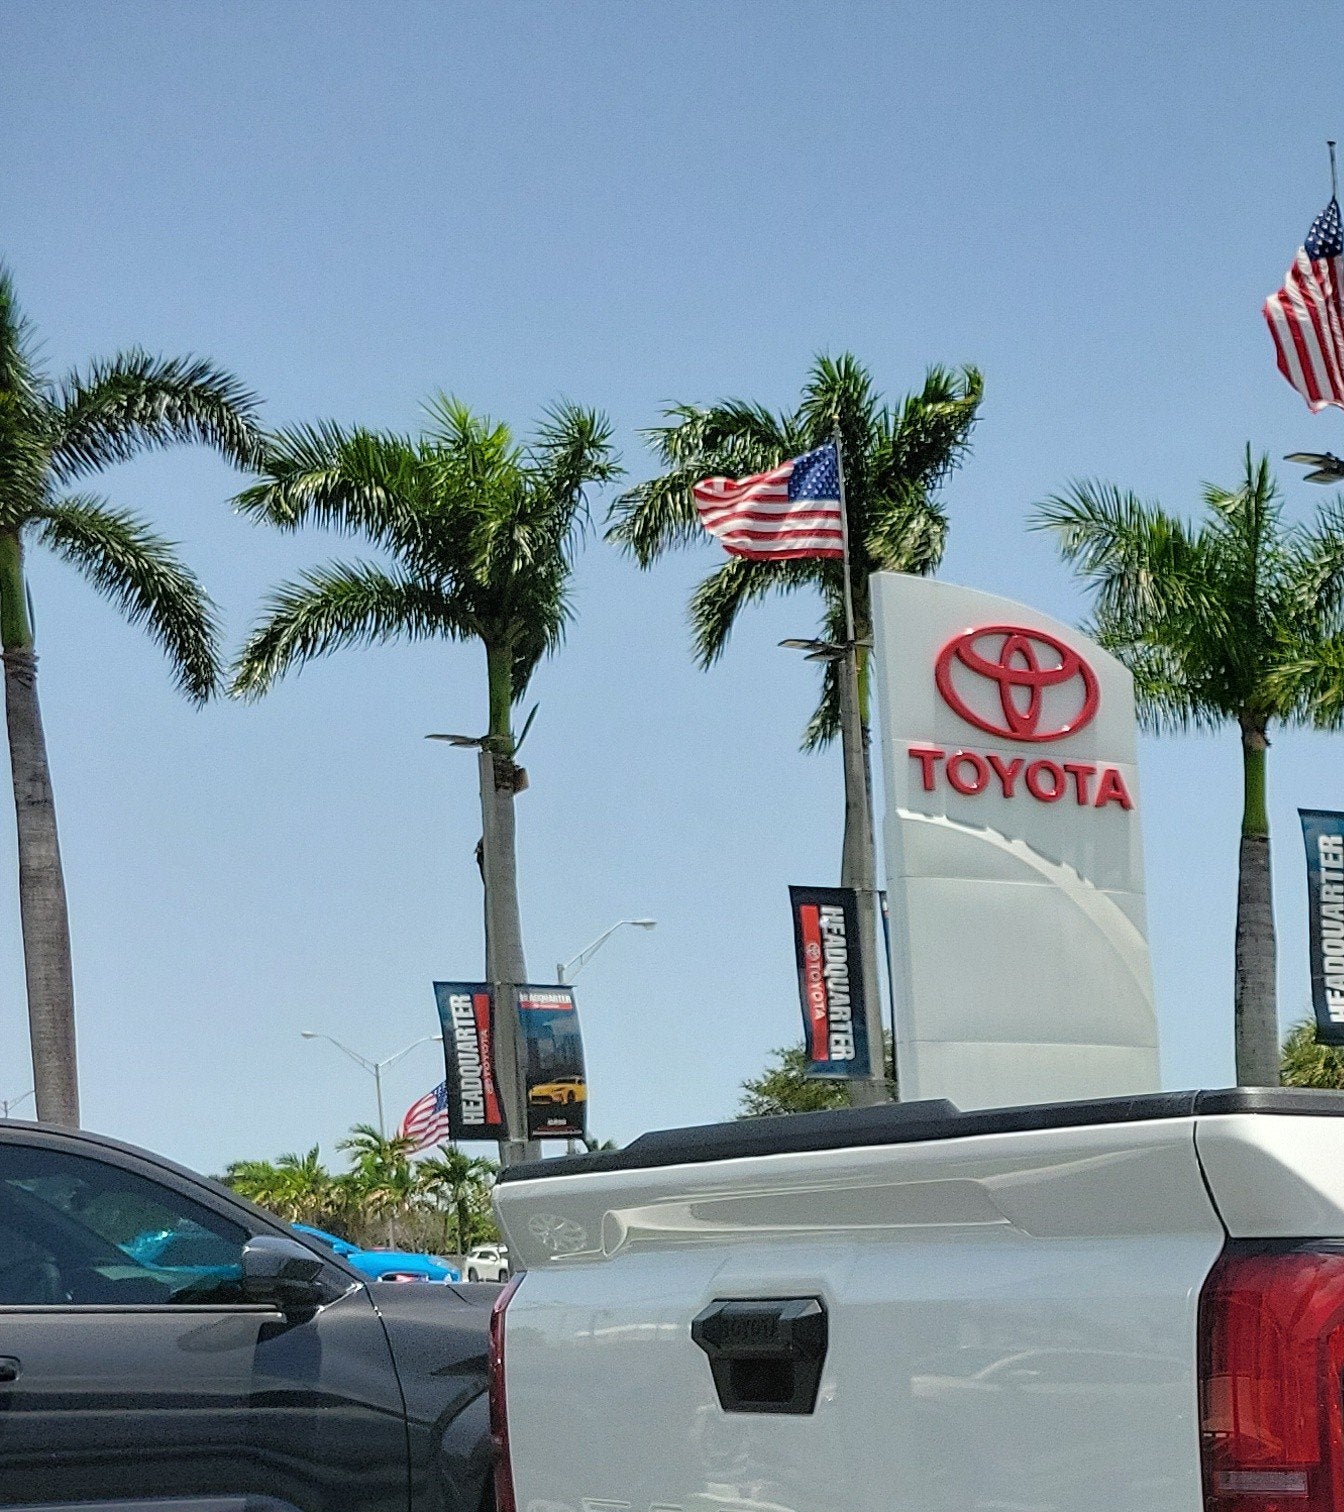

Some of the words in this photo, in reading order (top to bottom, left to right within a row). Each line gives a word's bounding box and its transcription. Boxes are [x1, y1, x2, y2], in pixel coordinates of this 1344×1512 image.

[908, 748, 1134, 811] TOYOTA
[809, 961, 826, 1021] TOYOTA
[820, 904, 856, 1061] HEADQUARTER
[450, 993, 485, 1125] HEADQUARTER
